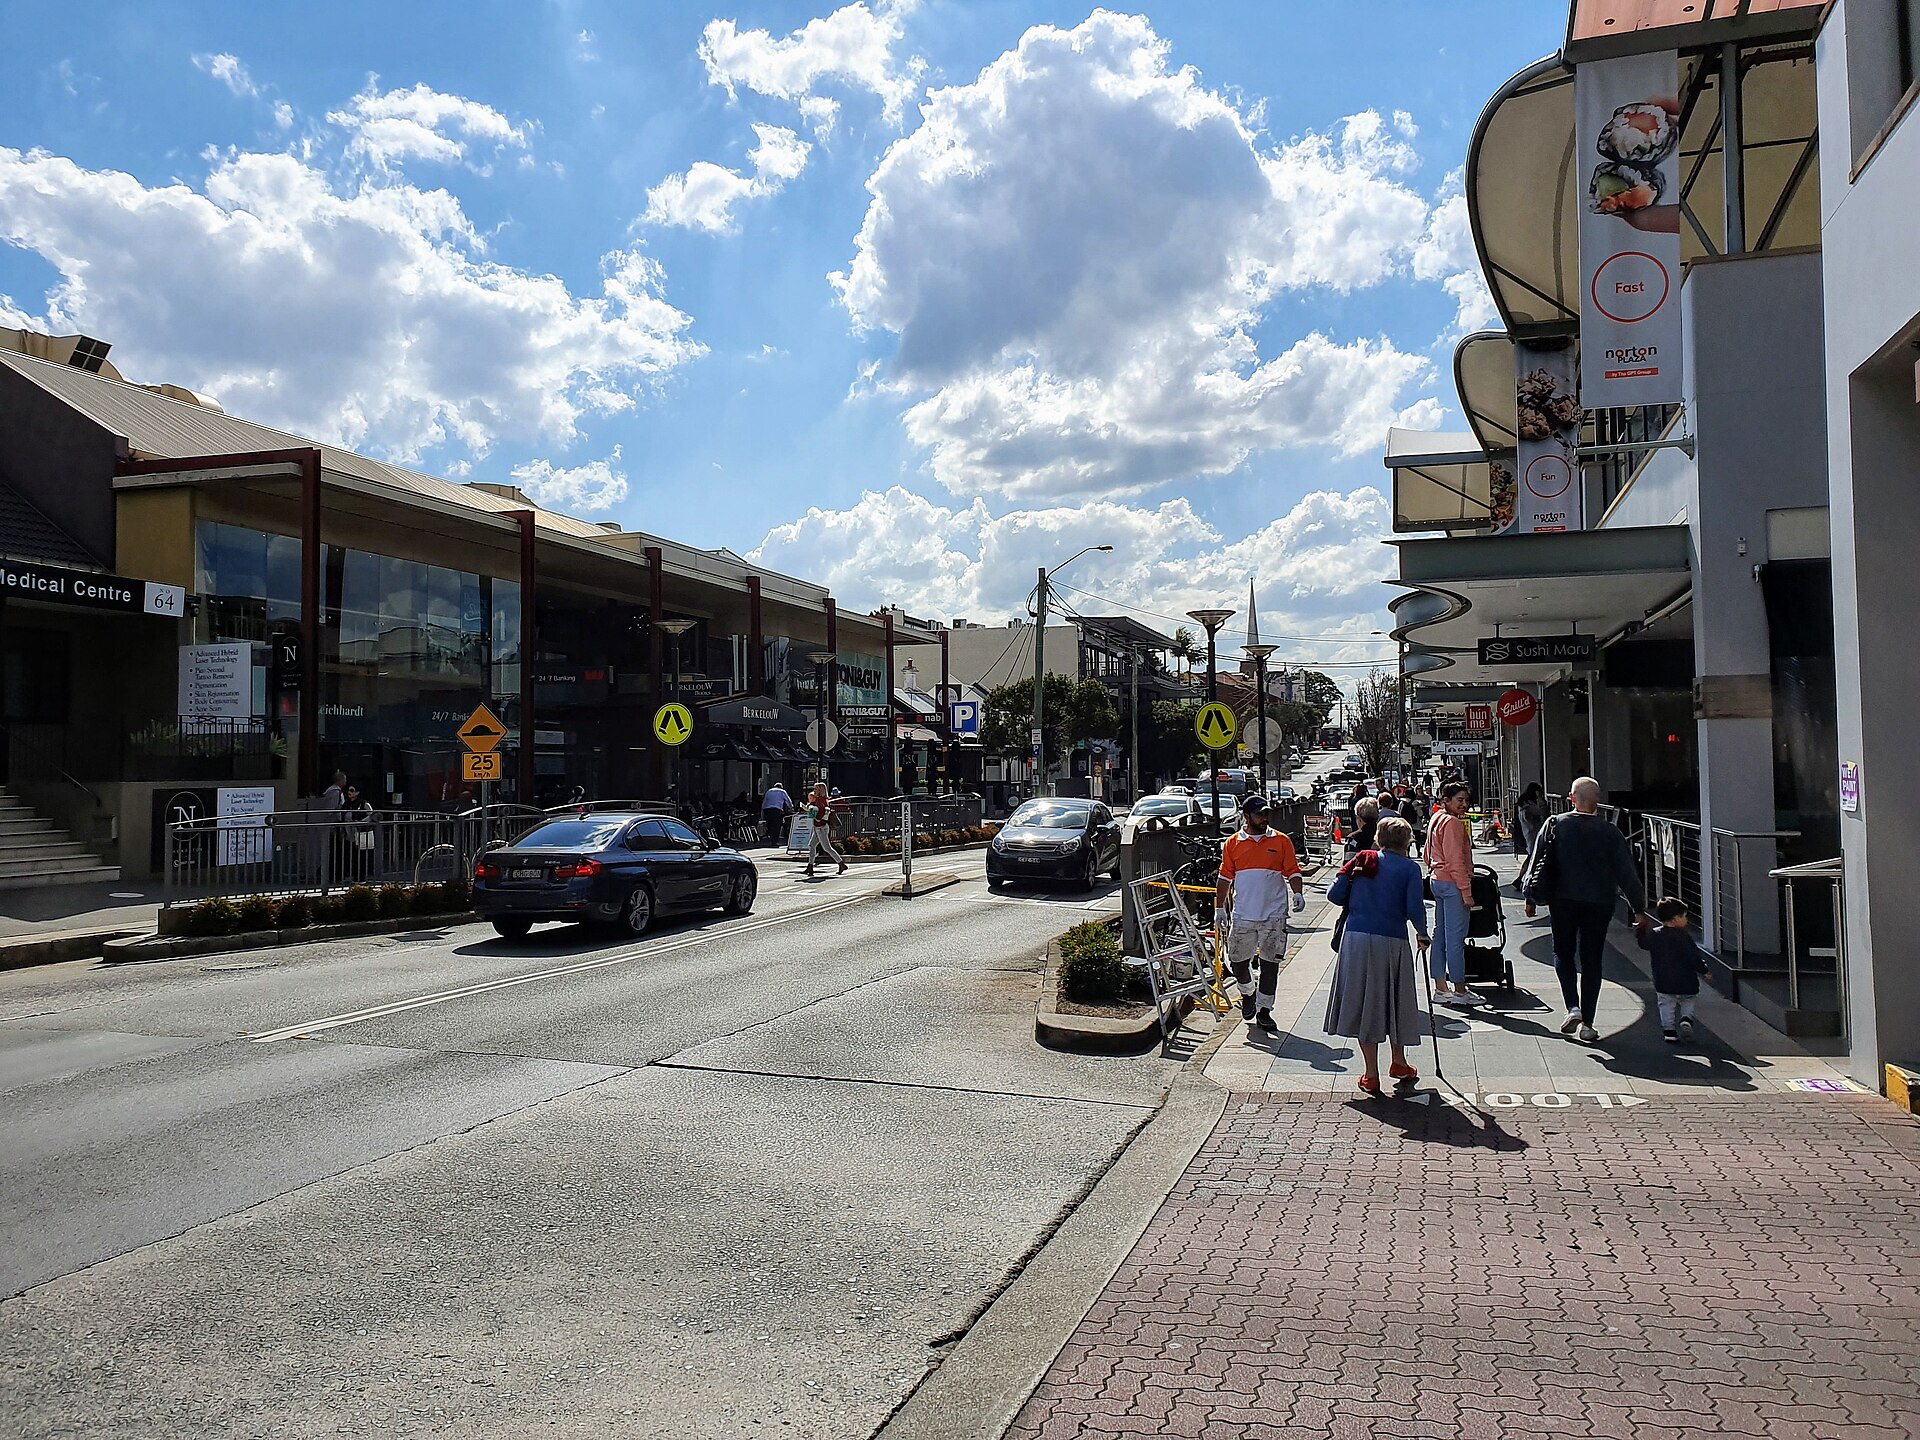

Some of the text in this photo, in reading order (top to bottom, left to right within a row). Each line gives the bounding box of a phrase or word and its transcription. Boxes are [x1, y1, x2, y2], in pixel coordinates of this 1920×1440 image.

[1615, 282, 1645, 294] Fast
[1605, 346, 1658, 359] norton
[1617, 354, 1647, 363] PLAZA
[1541, 473, 1556, 481] Fun
[1533, 512, 1566, 520] norton
[73, 580, 132, 602] Centre
[154, 593, 175, 610] 64
[283, 645, 297, 662] N
[1516, 643, 1590, 657] Sushi Maru
[319, 704, 364, 717] eichhardt
[1500, 696, 1531, 718] Grill'd
[431, 711, 449, 722] 24/7
[924, 713, 942, 722] nab
[954, 705, 974, 729] P
[1470, 719, 1485, 729] me
[470, 754, 494, 771] 25
